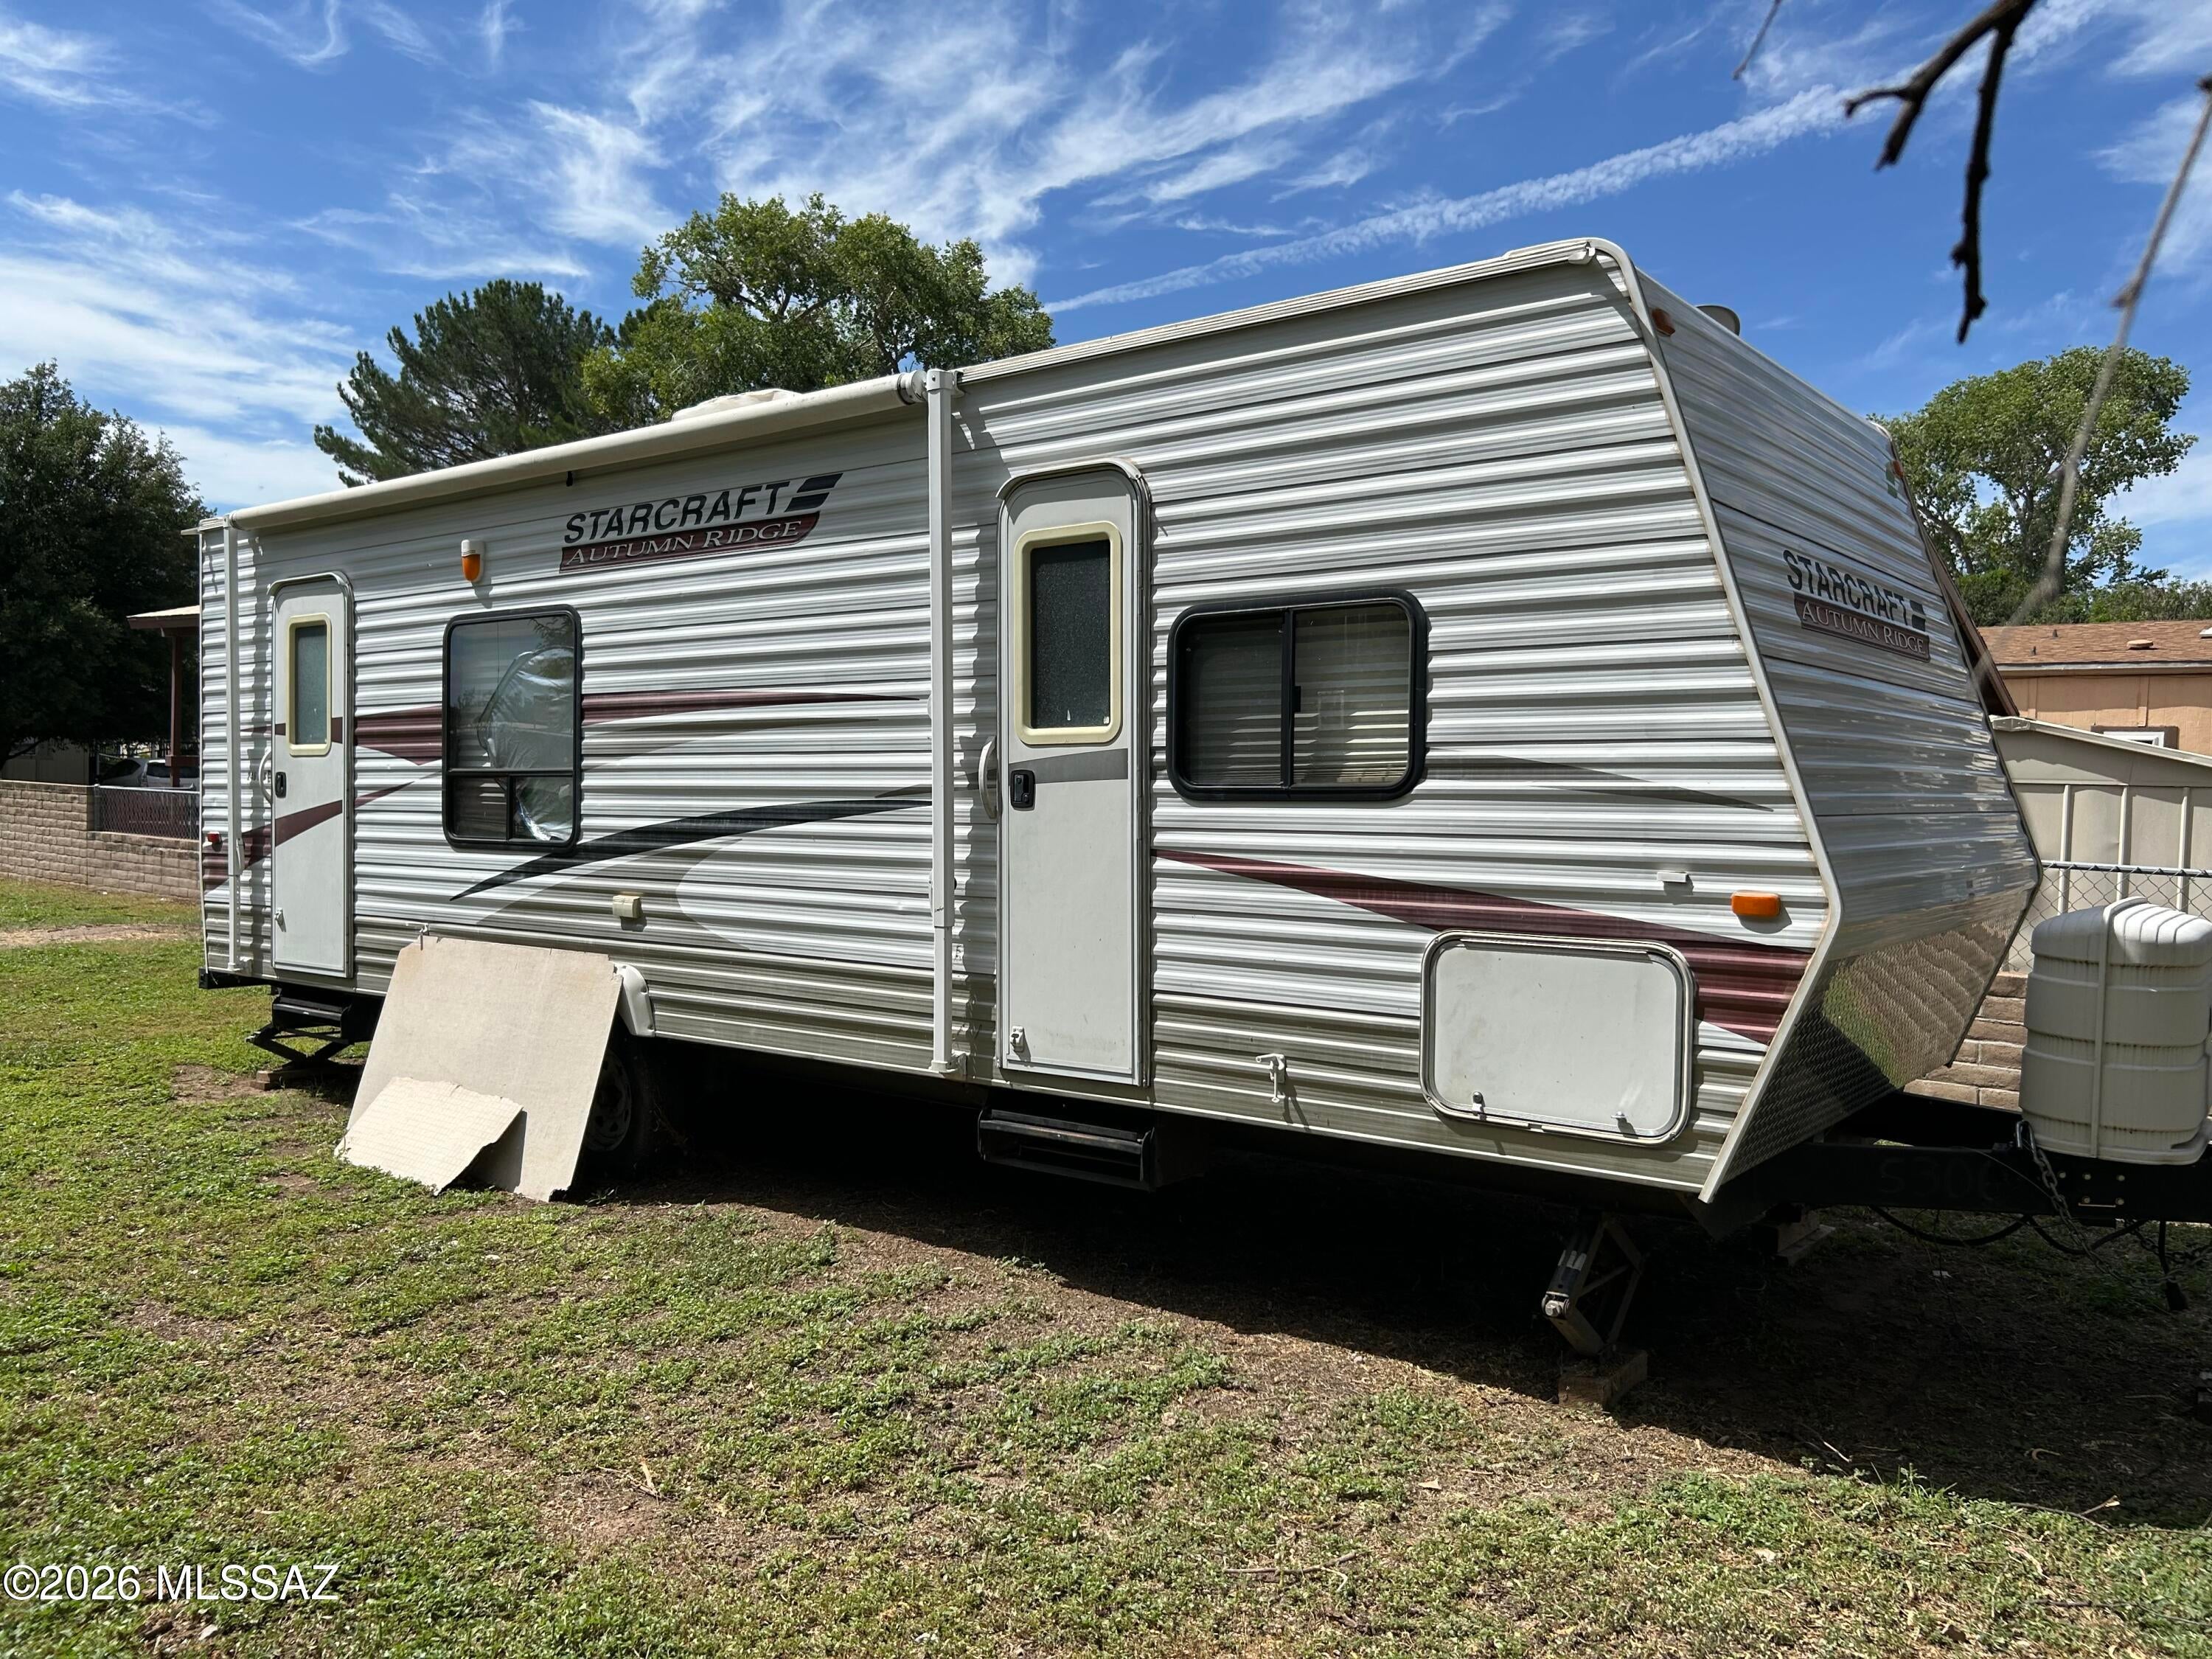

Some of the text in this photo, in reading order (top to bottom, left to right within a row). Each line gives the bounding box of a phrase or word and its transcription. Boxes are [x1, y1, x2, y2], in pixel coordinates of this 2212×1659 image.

[564, 481, 790, 544] STARCRAFT
[566, 520, 801, 566] AUTUMN RIDGE
[1783, 549, 1908, 625] STARCRAFT
[1802, 601, 1926, 654] AUTUMN RIDGE
